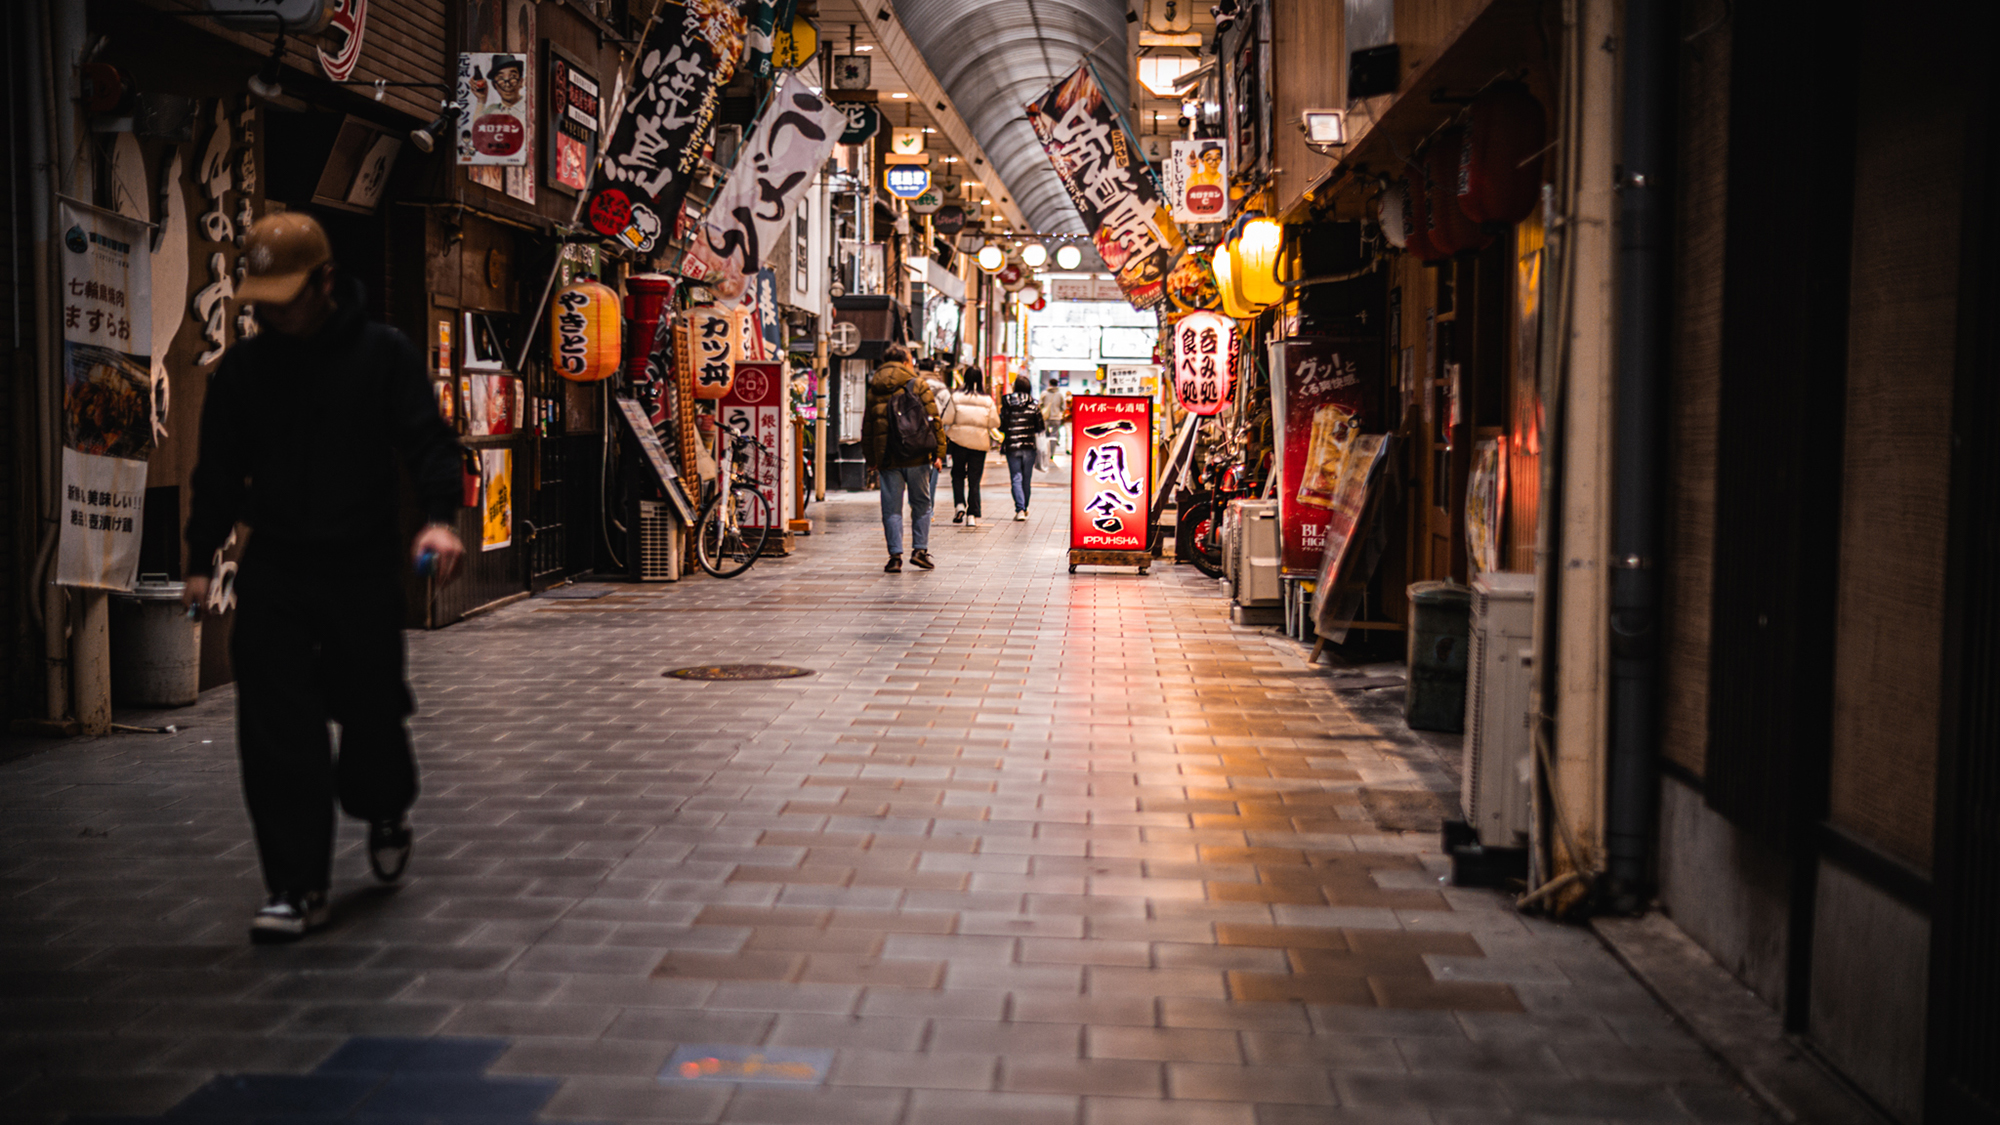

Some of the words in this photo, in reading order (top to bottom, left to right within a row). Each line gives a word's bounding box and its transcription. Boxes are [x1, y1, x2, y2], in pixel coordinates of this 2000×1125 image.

[478, 124, 519, 134] オロナミン
[838, 102, 866, 129] 花
[494, 133, 504, 142] C
[706, 93, 825, 276] うどん
[1190, 191, 1221, 199] オロナミン
[65, 305, 130, 340] ますらお
[557, 290, 590, 376] やきとり
[699, 316, 730, 387] カツ丼
[1182, 327, 1198, 404] 食べ処
[1200, 327, 1217, 404] 呑み処
[1079, 402, 1145, 413] ハイボール酒場
[1083, 535, 1139, 545] IPPUHSHA
